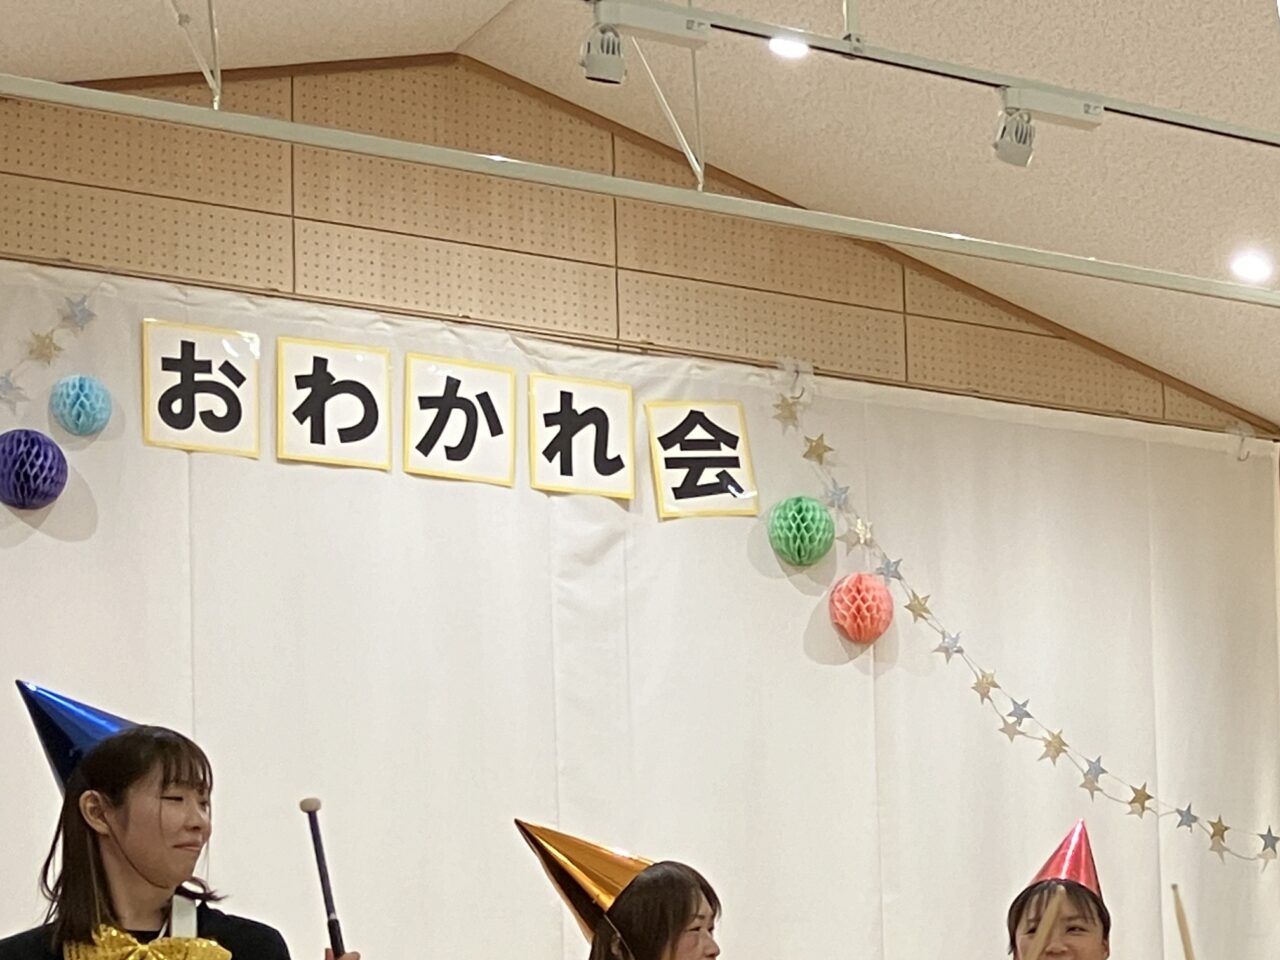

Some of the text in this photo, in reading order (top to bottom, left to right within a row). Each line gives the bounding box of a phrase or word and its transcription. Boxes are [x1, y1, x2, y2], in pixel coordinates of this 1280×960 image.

[157, 340, 744, 499] おわかれ会
